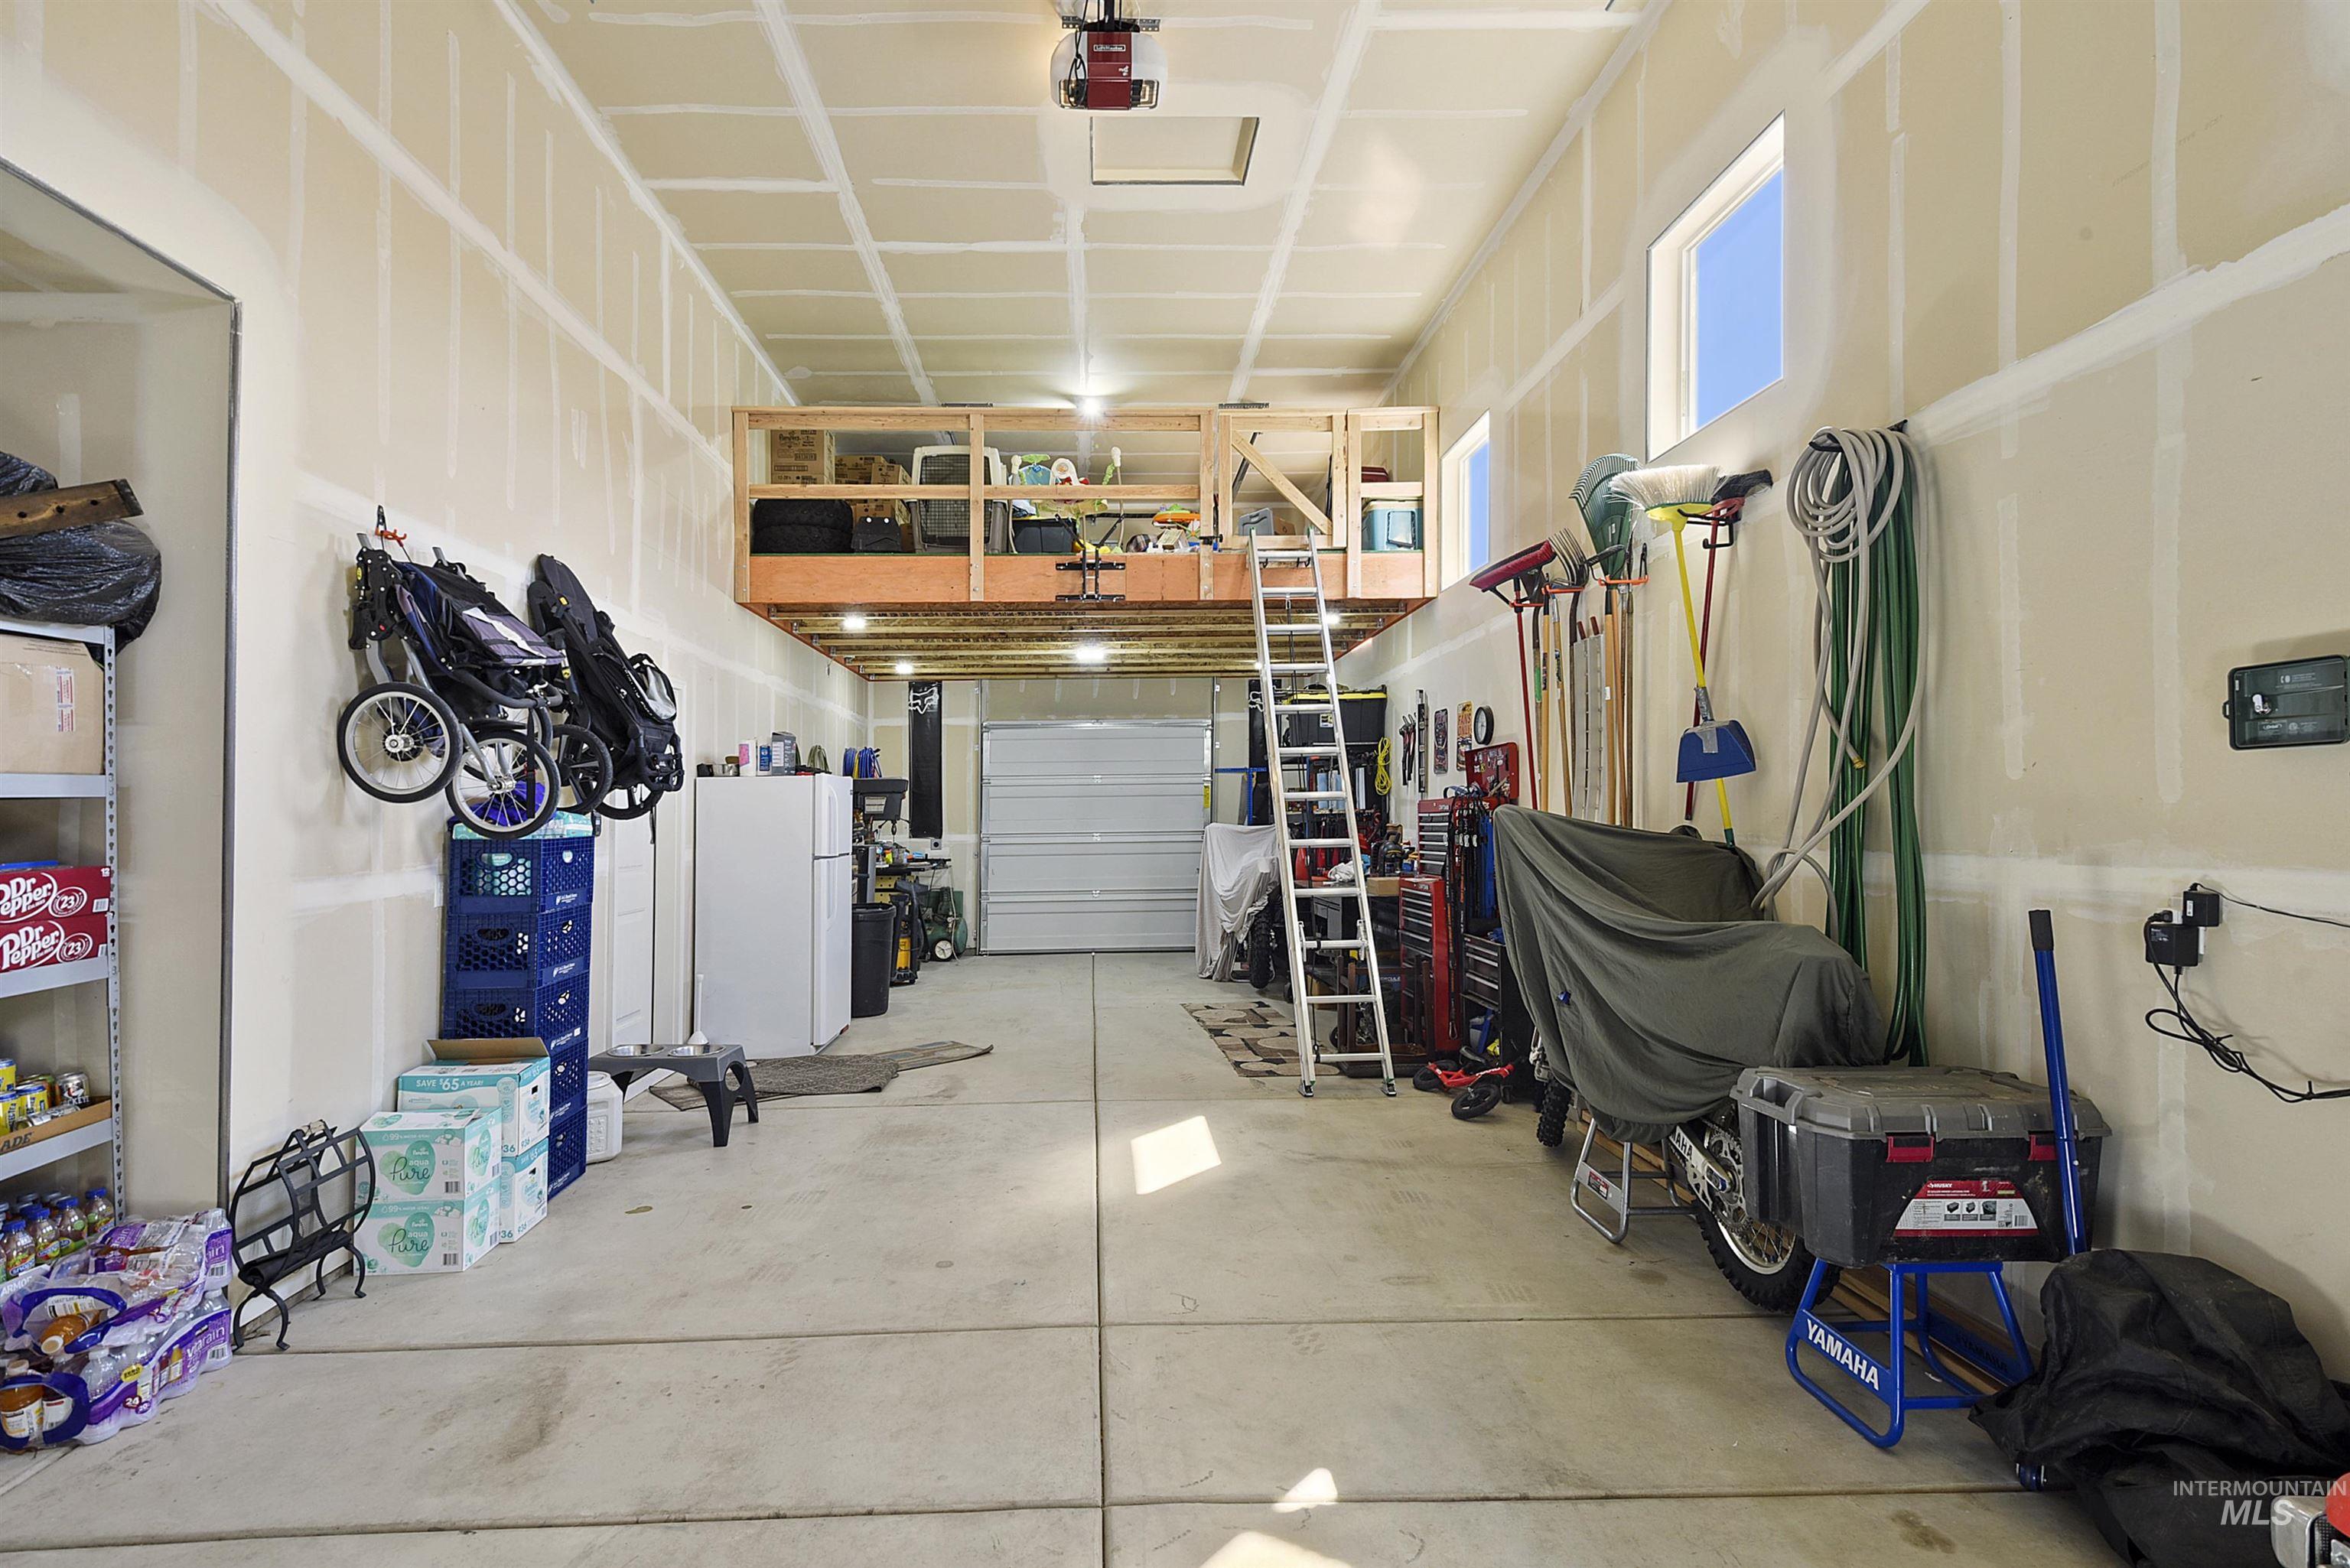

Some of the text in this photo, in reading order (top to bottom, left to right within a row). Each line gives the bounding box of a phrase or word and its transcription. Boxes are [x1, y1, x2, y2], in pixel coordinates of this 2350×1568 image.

[10, 877, 37, 899] Dr
[60, 896, 75, 909] 23
[18, 926, 44, 948] Dr
[0, 931, 60, 971] Pepper
[68, 942, 81, 955] 23
[439, 1078, 459, 1091] $65
[502, 1144, 516, 1153] 36
[389, 1156, 431, 1181] Pure
[389, 1228, 429, 1253] Pure
[499, 1230, 513, 1238] 36
[1807, 1318, 1880, 1391] YAMAHA
[125, 1397, 140, 1406] 24
